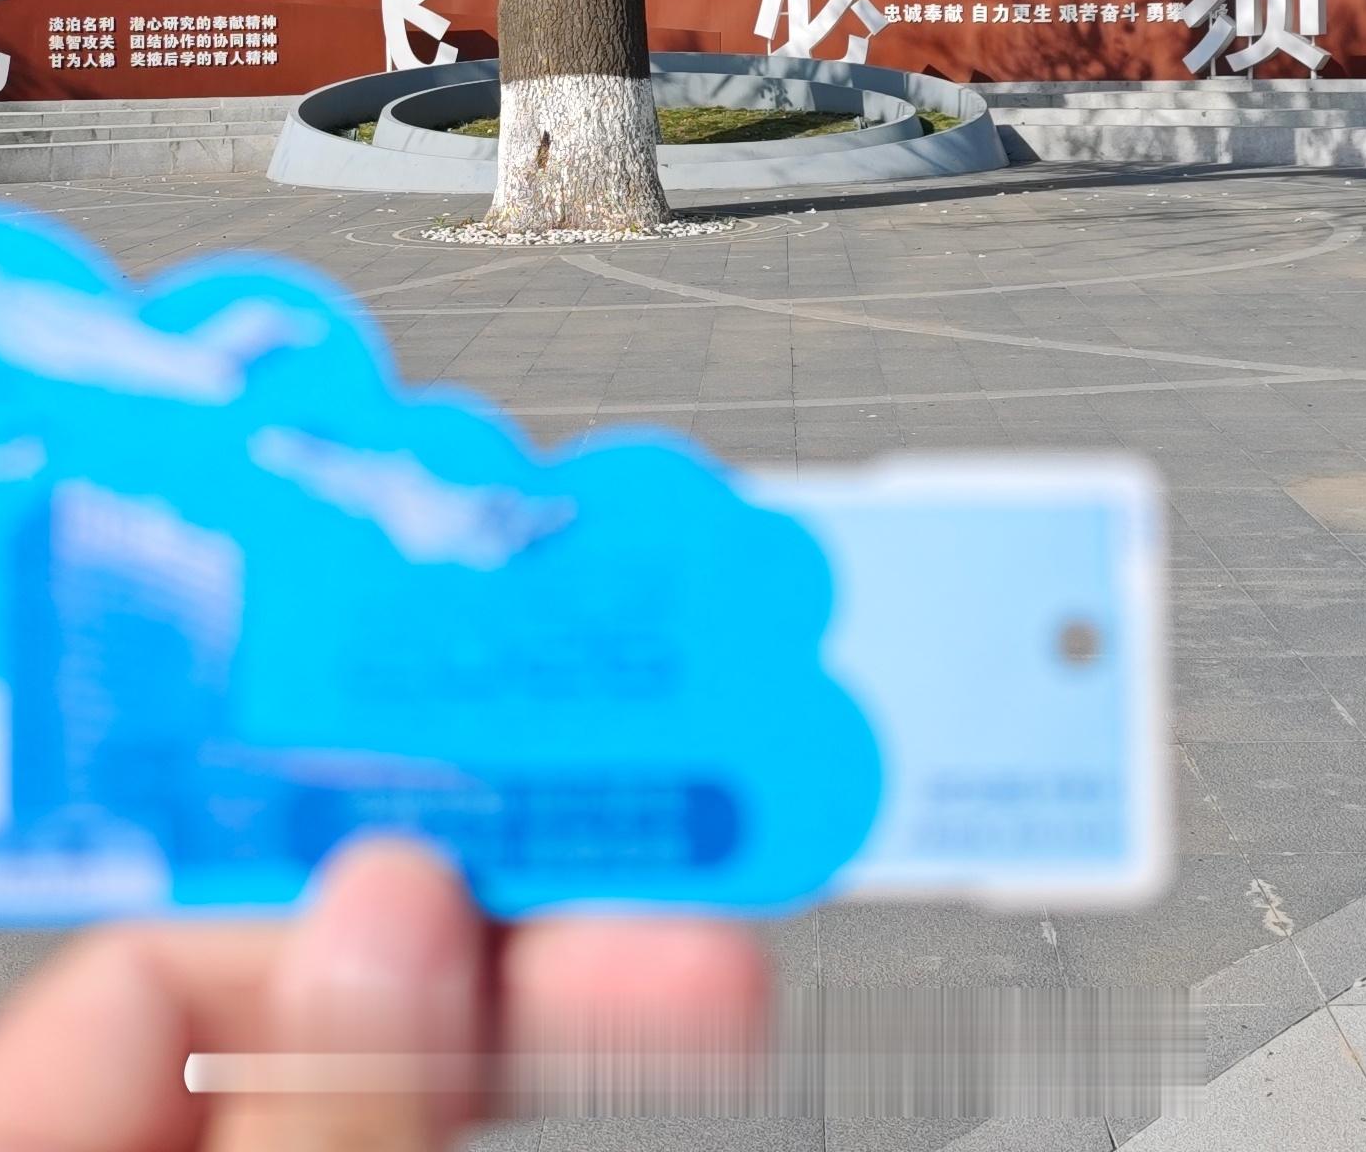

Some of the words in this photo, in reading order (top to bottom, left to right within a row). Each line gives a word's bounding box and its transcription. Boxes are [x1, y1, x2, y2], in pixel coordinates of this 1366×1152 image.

[884, 3, 964, 24] 忠诚奉献
[971, 3, 1053, 24] 自力更生
[1059, 2, 1140, 23] 艰苦奋斗
[48, 16, 115, 32] 淡泊名利
[129, 15, 278, 32] 潜心研究的奉献精神
[48, 34, 115, 50] 集智攻关
[129, 33, 278, 50] 团结协作的协同精神
[48, 52, 116, 68] 甘为人梯
[130, 50, 279, 67] 奖掖后学的育人精神
